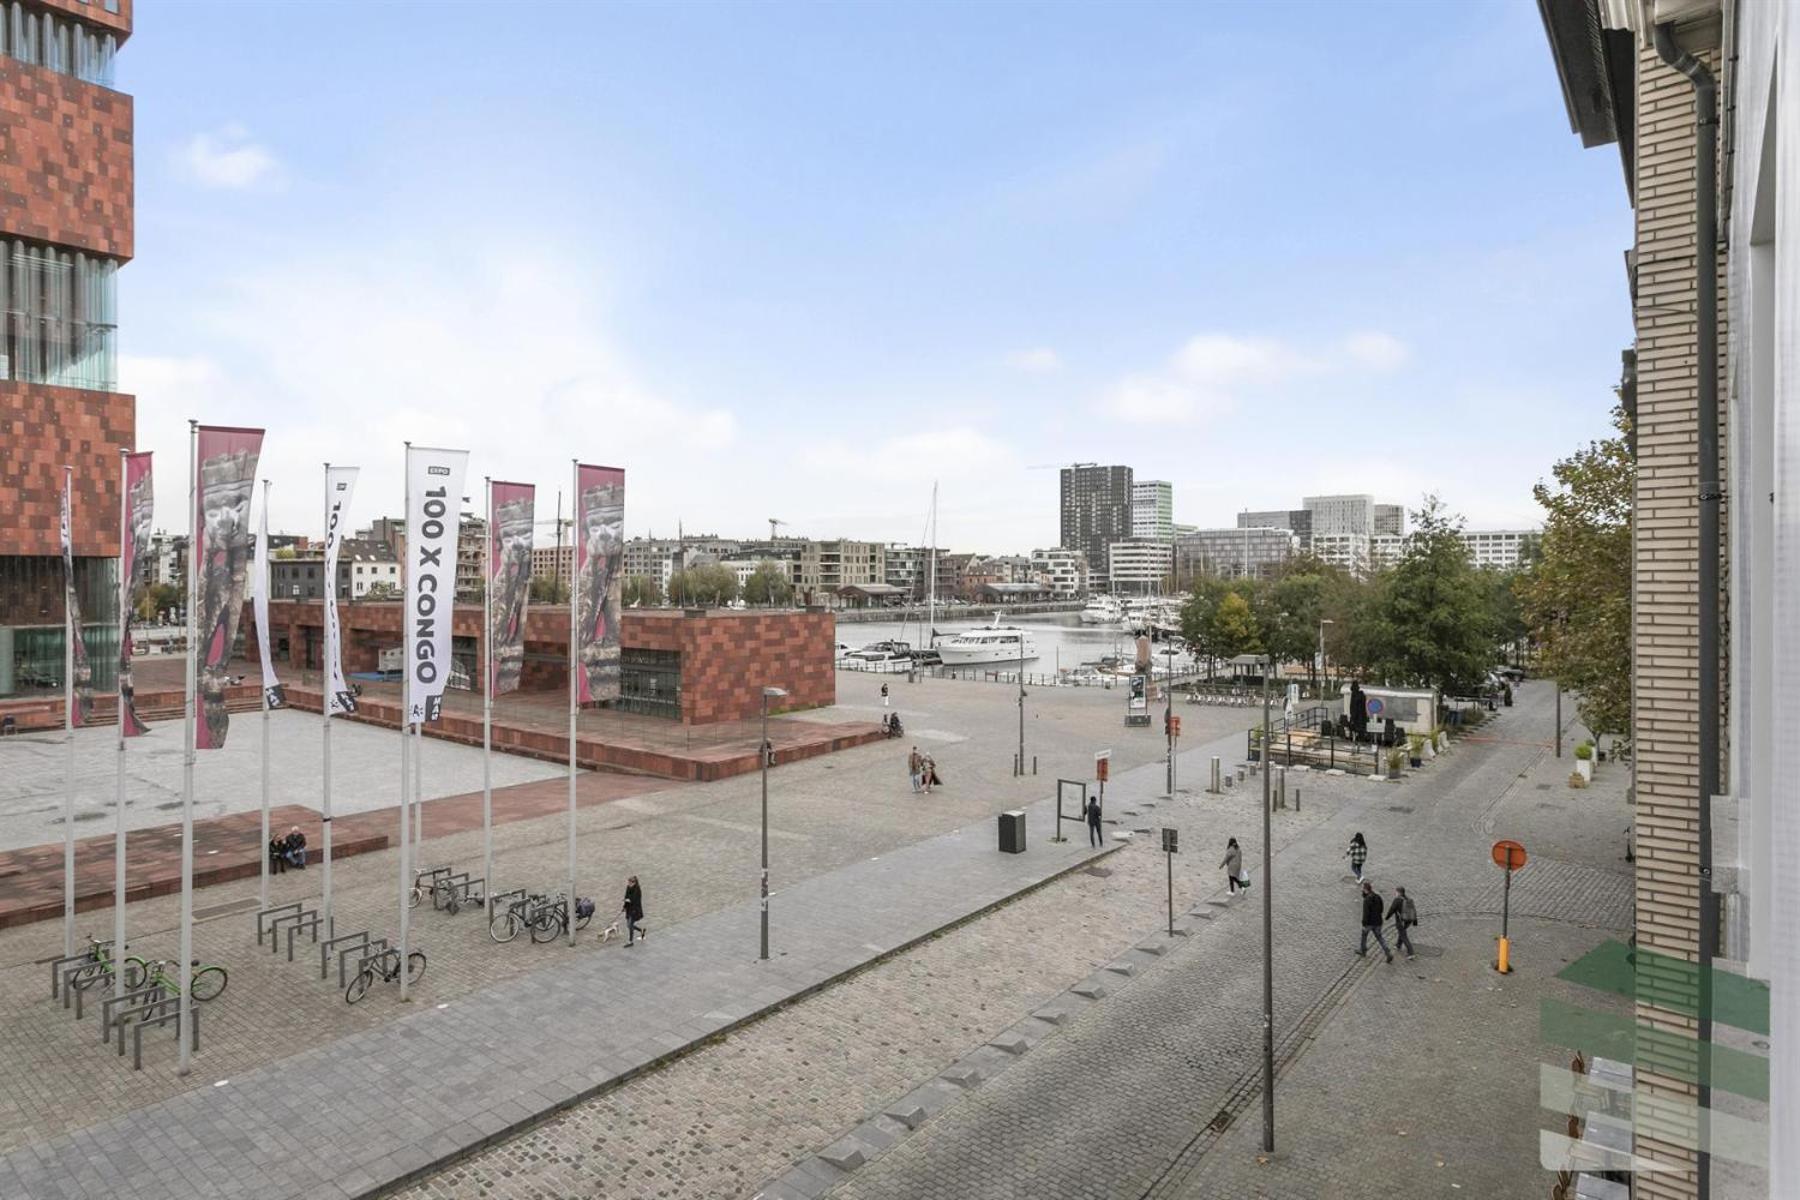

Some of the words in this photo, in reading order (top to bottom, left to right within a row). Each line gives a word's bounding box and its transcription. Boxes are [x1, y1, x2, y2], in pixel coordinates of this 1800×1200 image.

[429, 467, 450, 475] EXPO
[423, 486, 447, 539] 100
[419, 546, 442, 567] X
[416, 574, 438, 684] CONGO
